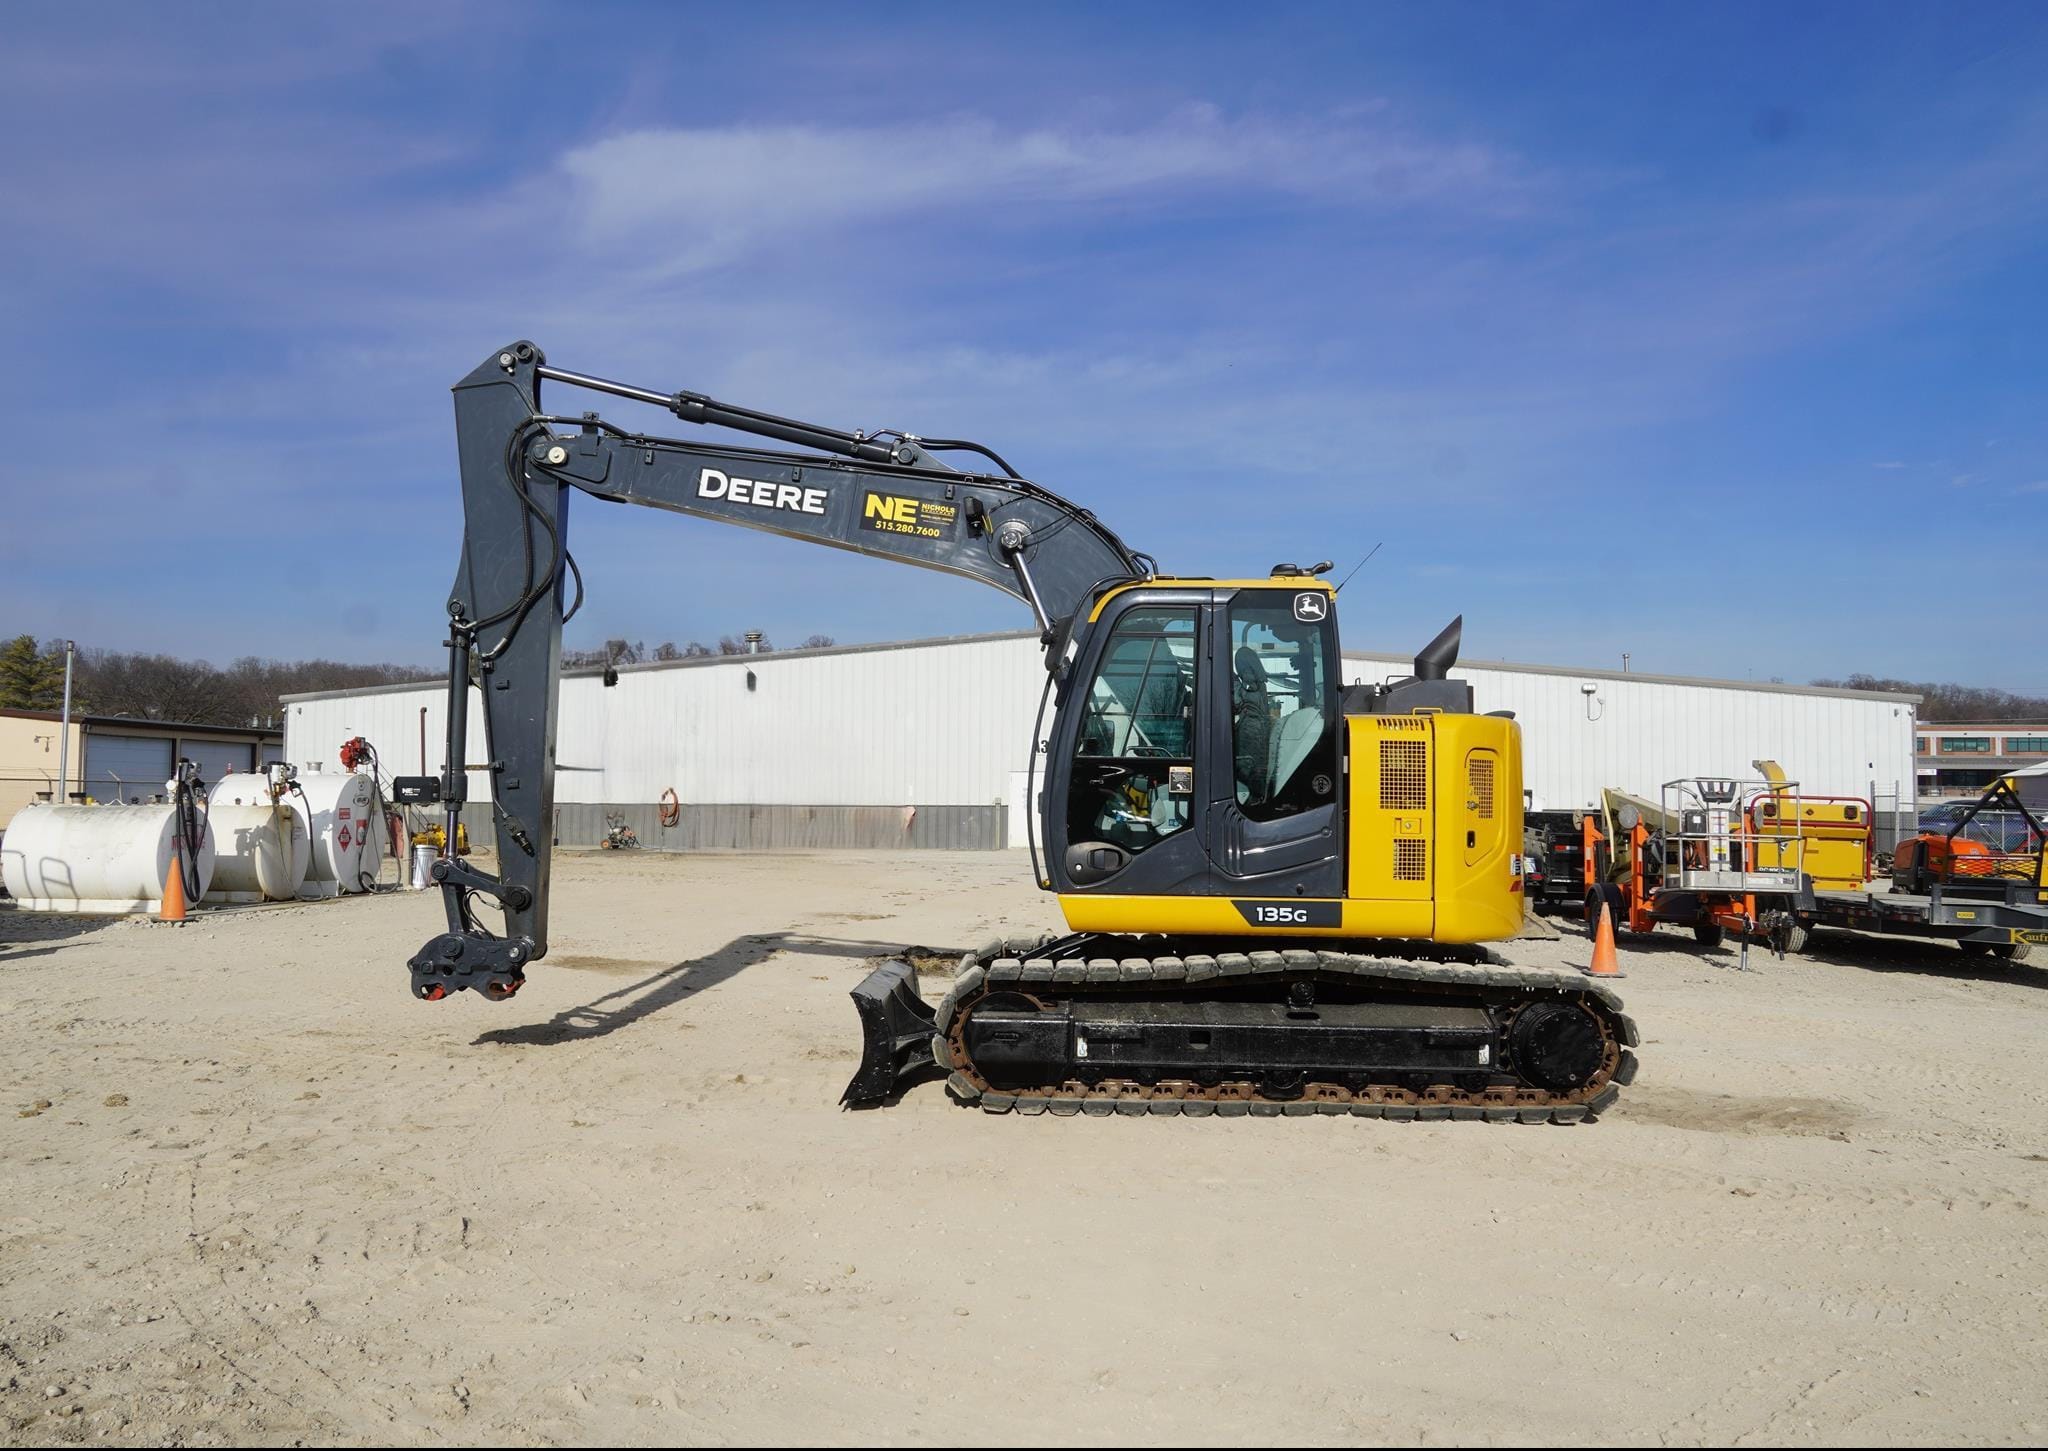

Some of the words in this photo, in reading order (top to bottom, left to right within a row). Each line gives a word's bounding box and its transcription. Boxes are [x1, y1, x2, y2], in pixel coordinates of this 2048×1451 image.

[698, 468, 828, 514] DEERE
[865, 494, 919, 523] NE
[921, 503, 955, 513] NICHOLS
[876, 520, 940, 537] 515.280.7600
[1257, 907, 1307, 923] 135G
